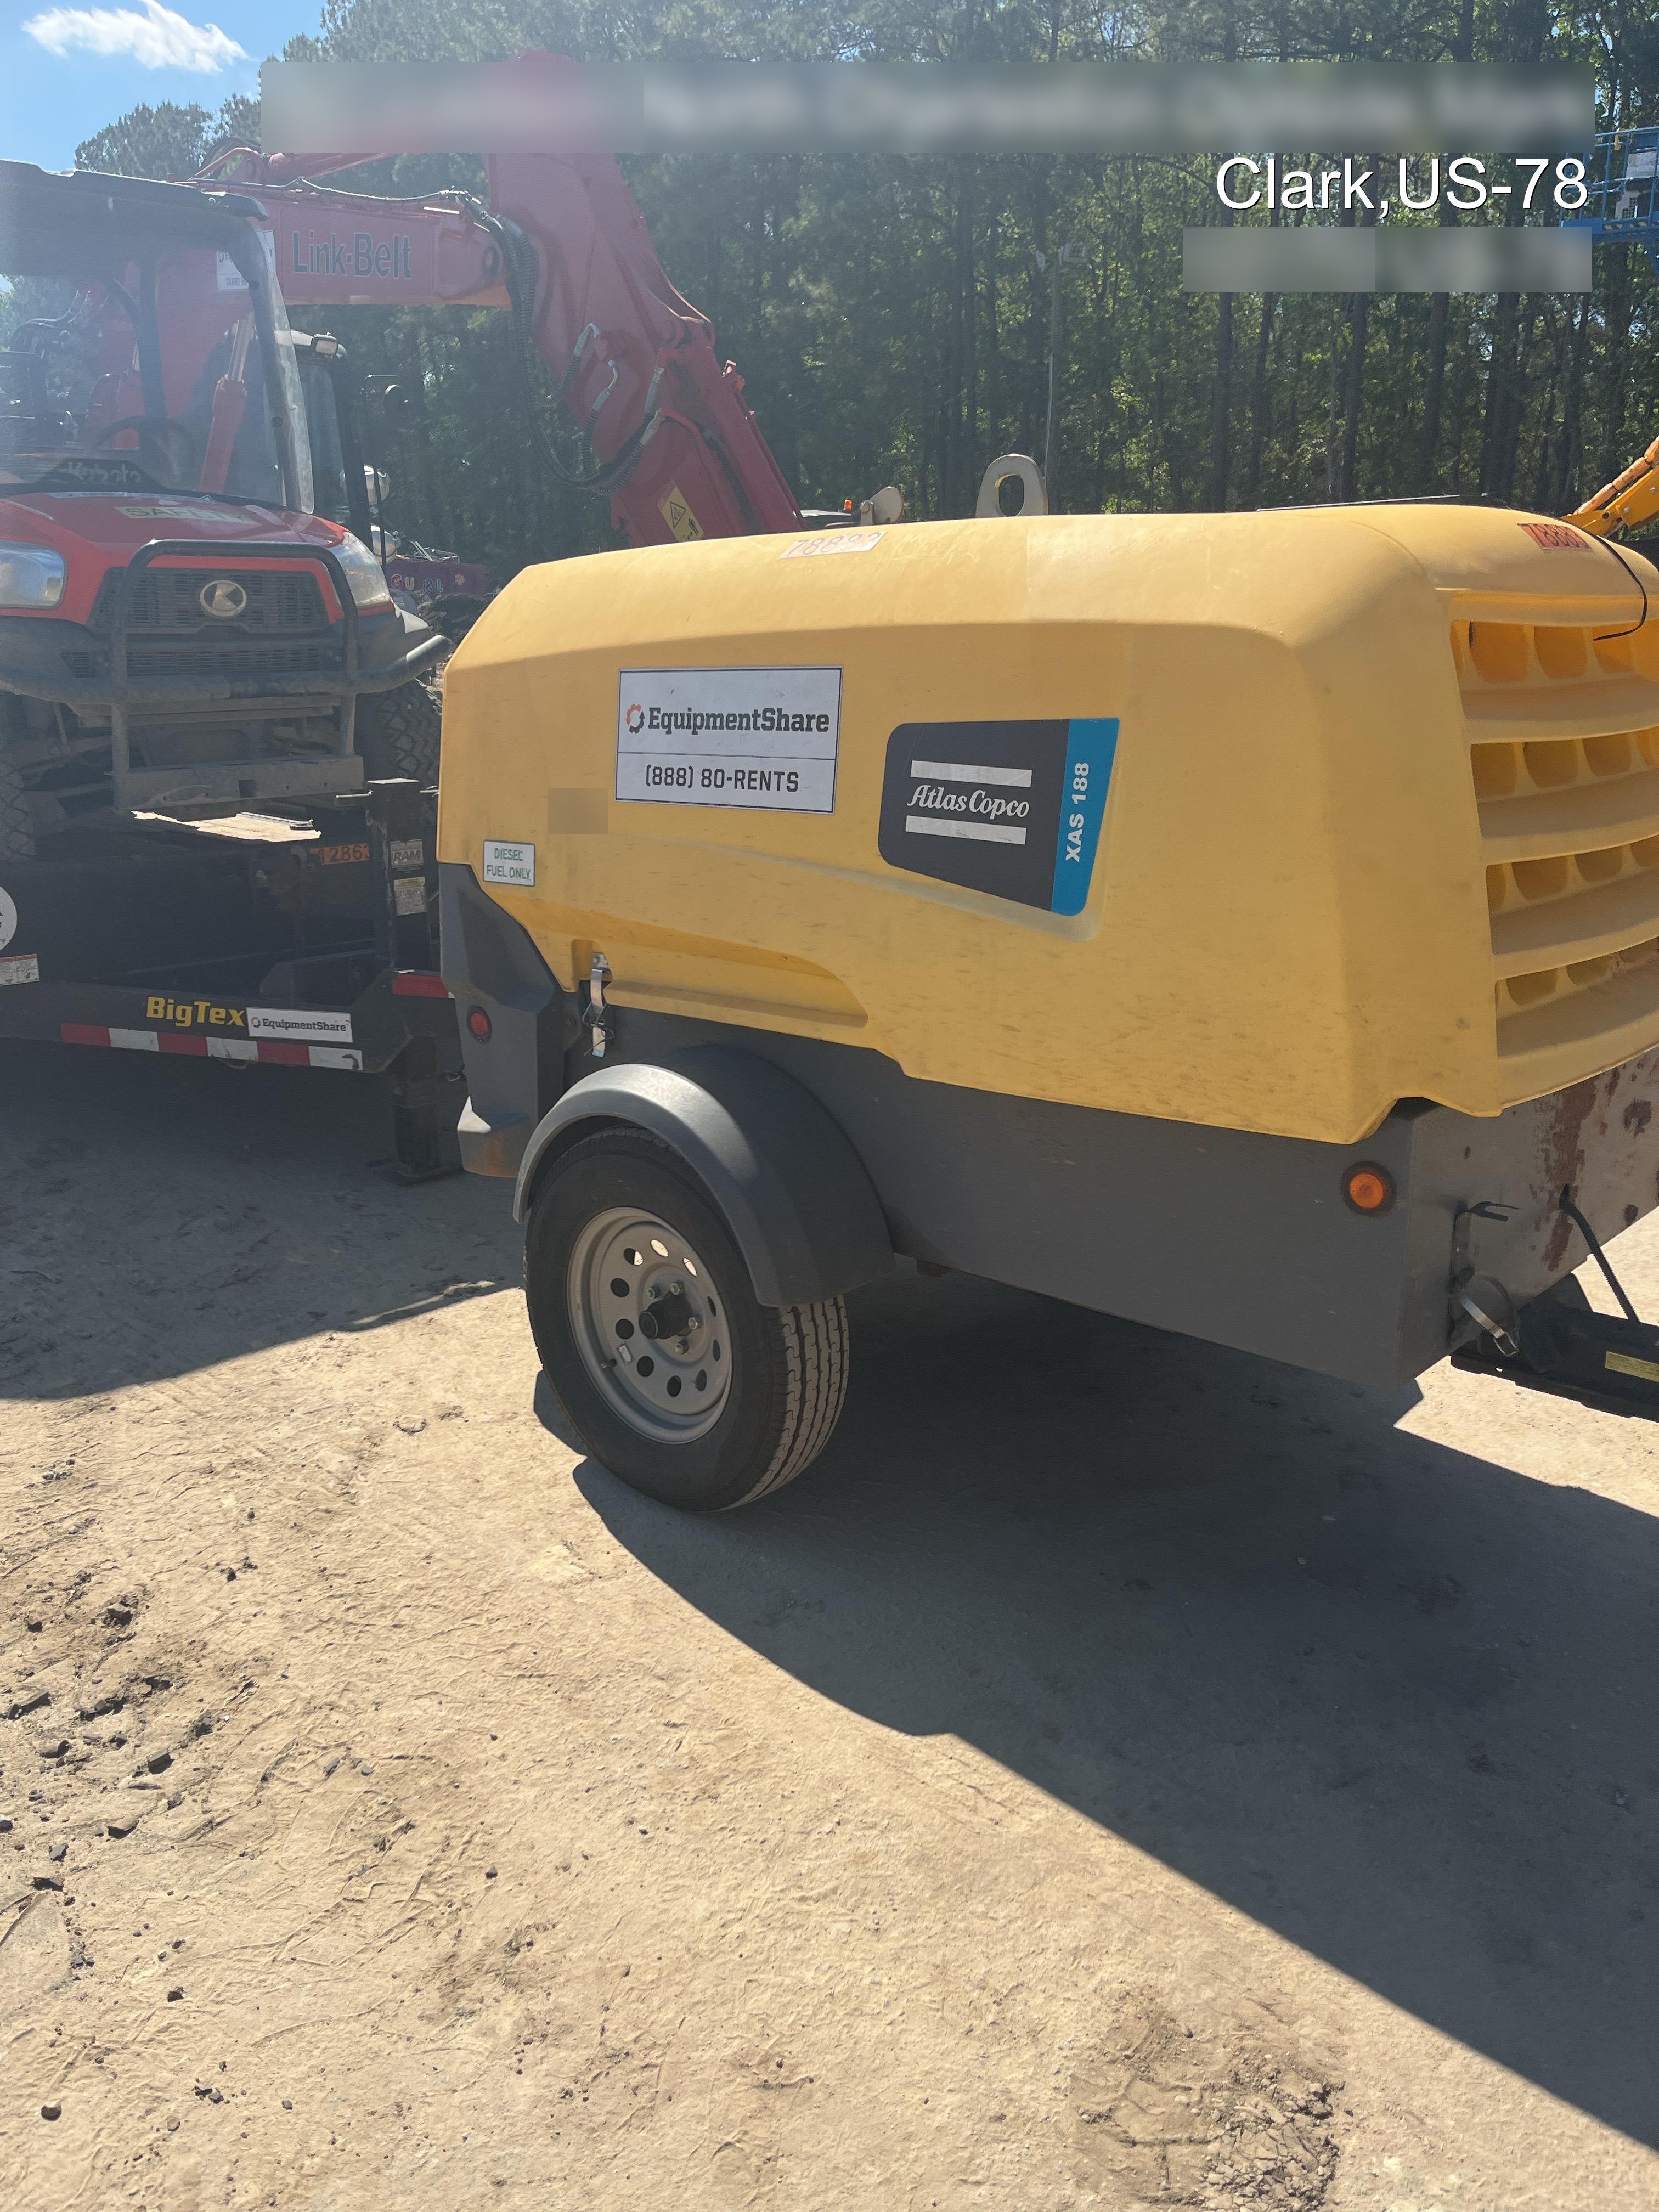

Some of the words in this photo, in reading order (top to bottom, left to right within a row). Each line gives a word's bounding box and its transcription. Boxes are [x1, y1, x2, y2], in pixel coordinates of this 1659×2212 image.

[293, 230, 411, 279] Link-Belt
[648, 707, 830, 735] EquipmentShare
[645, 764, 693, 789] (888)
[701, 768, 799, 793] 80-RENTS
[1071, 763, 1090, 805] 188
[907, 785, 968, 812] Atlas
[969, 789, 1030, 820] Copco
[1065, 813, 1084, 863] XAS
[494, 848, 523, 861] DIESEL
[487, 864, 507, 877] FUEL
[509, 867, 531, 881] ONLY
[146, 996, 245, 1028] BigTex
[262, 1018, 347, 1032] EquipmentShare
